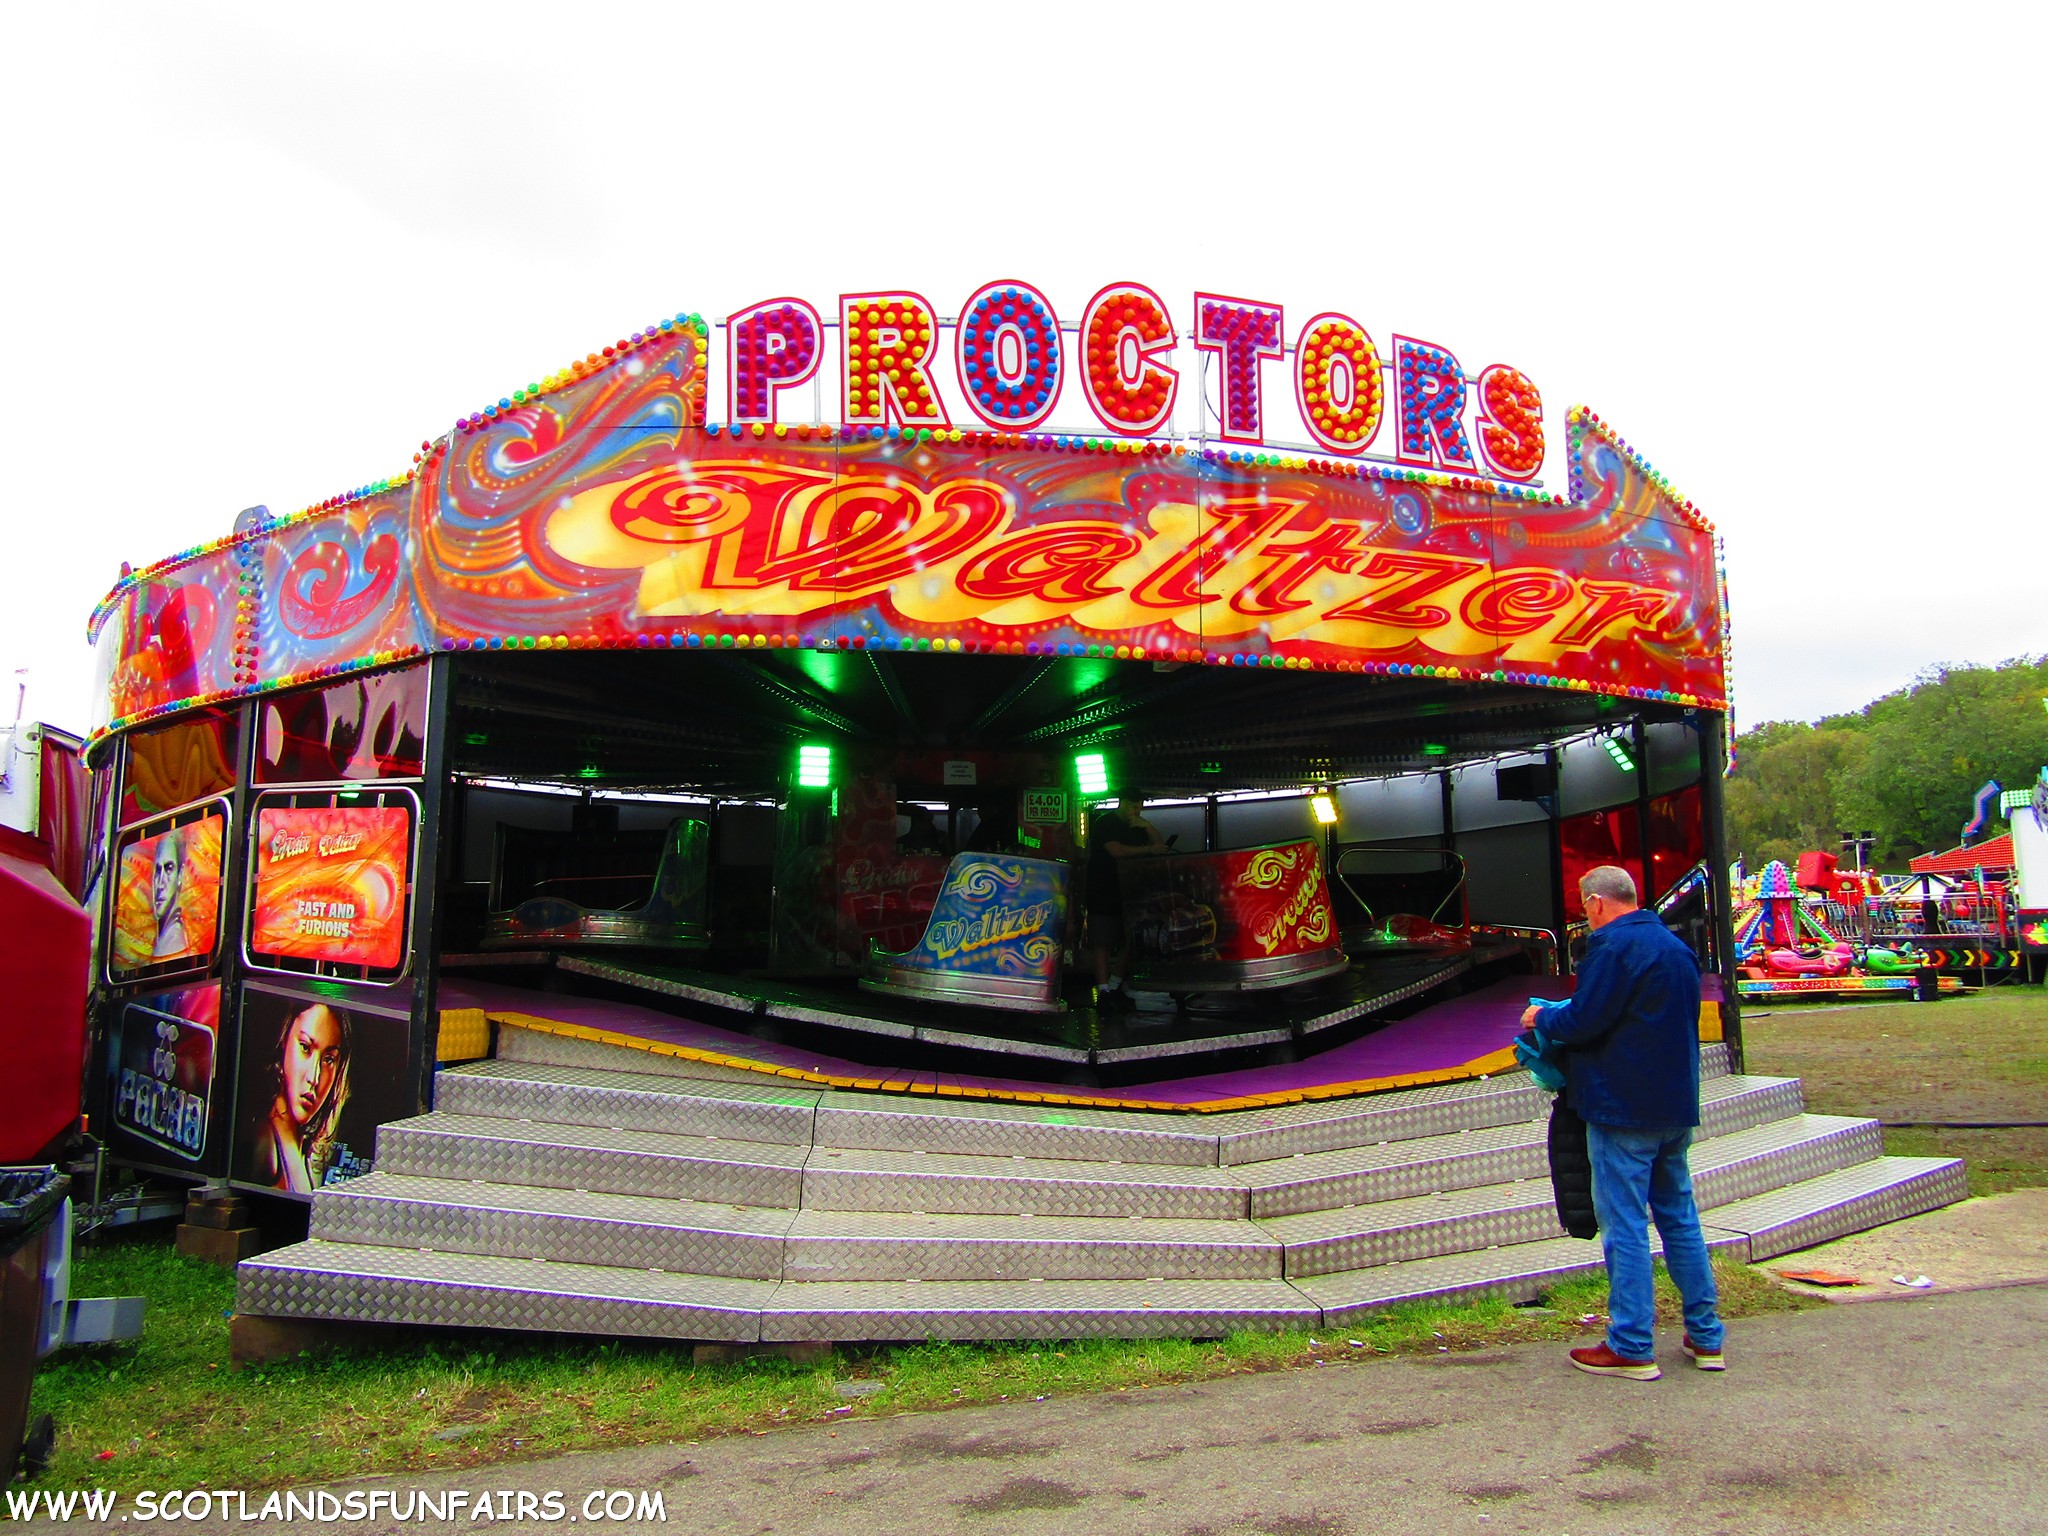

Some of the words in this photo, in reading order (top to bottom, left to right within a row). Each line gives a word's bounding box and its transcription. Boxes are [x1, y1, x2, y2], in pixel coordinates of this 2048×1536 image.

[726, 279, 1546, 482] PROCTORS
[547, 459, 1684, 662] Waltzer
[1029, 795, 1061, 806] £4.00
[298, 901, 326, 916] FAST
[329, 903, 355, 919] AND
[297, 919, 350, 937] FURIOUS
[926, 900, 1053, 960] Waltzer
[339, 1150, 371, 1172] FAS
